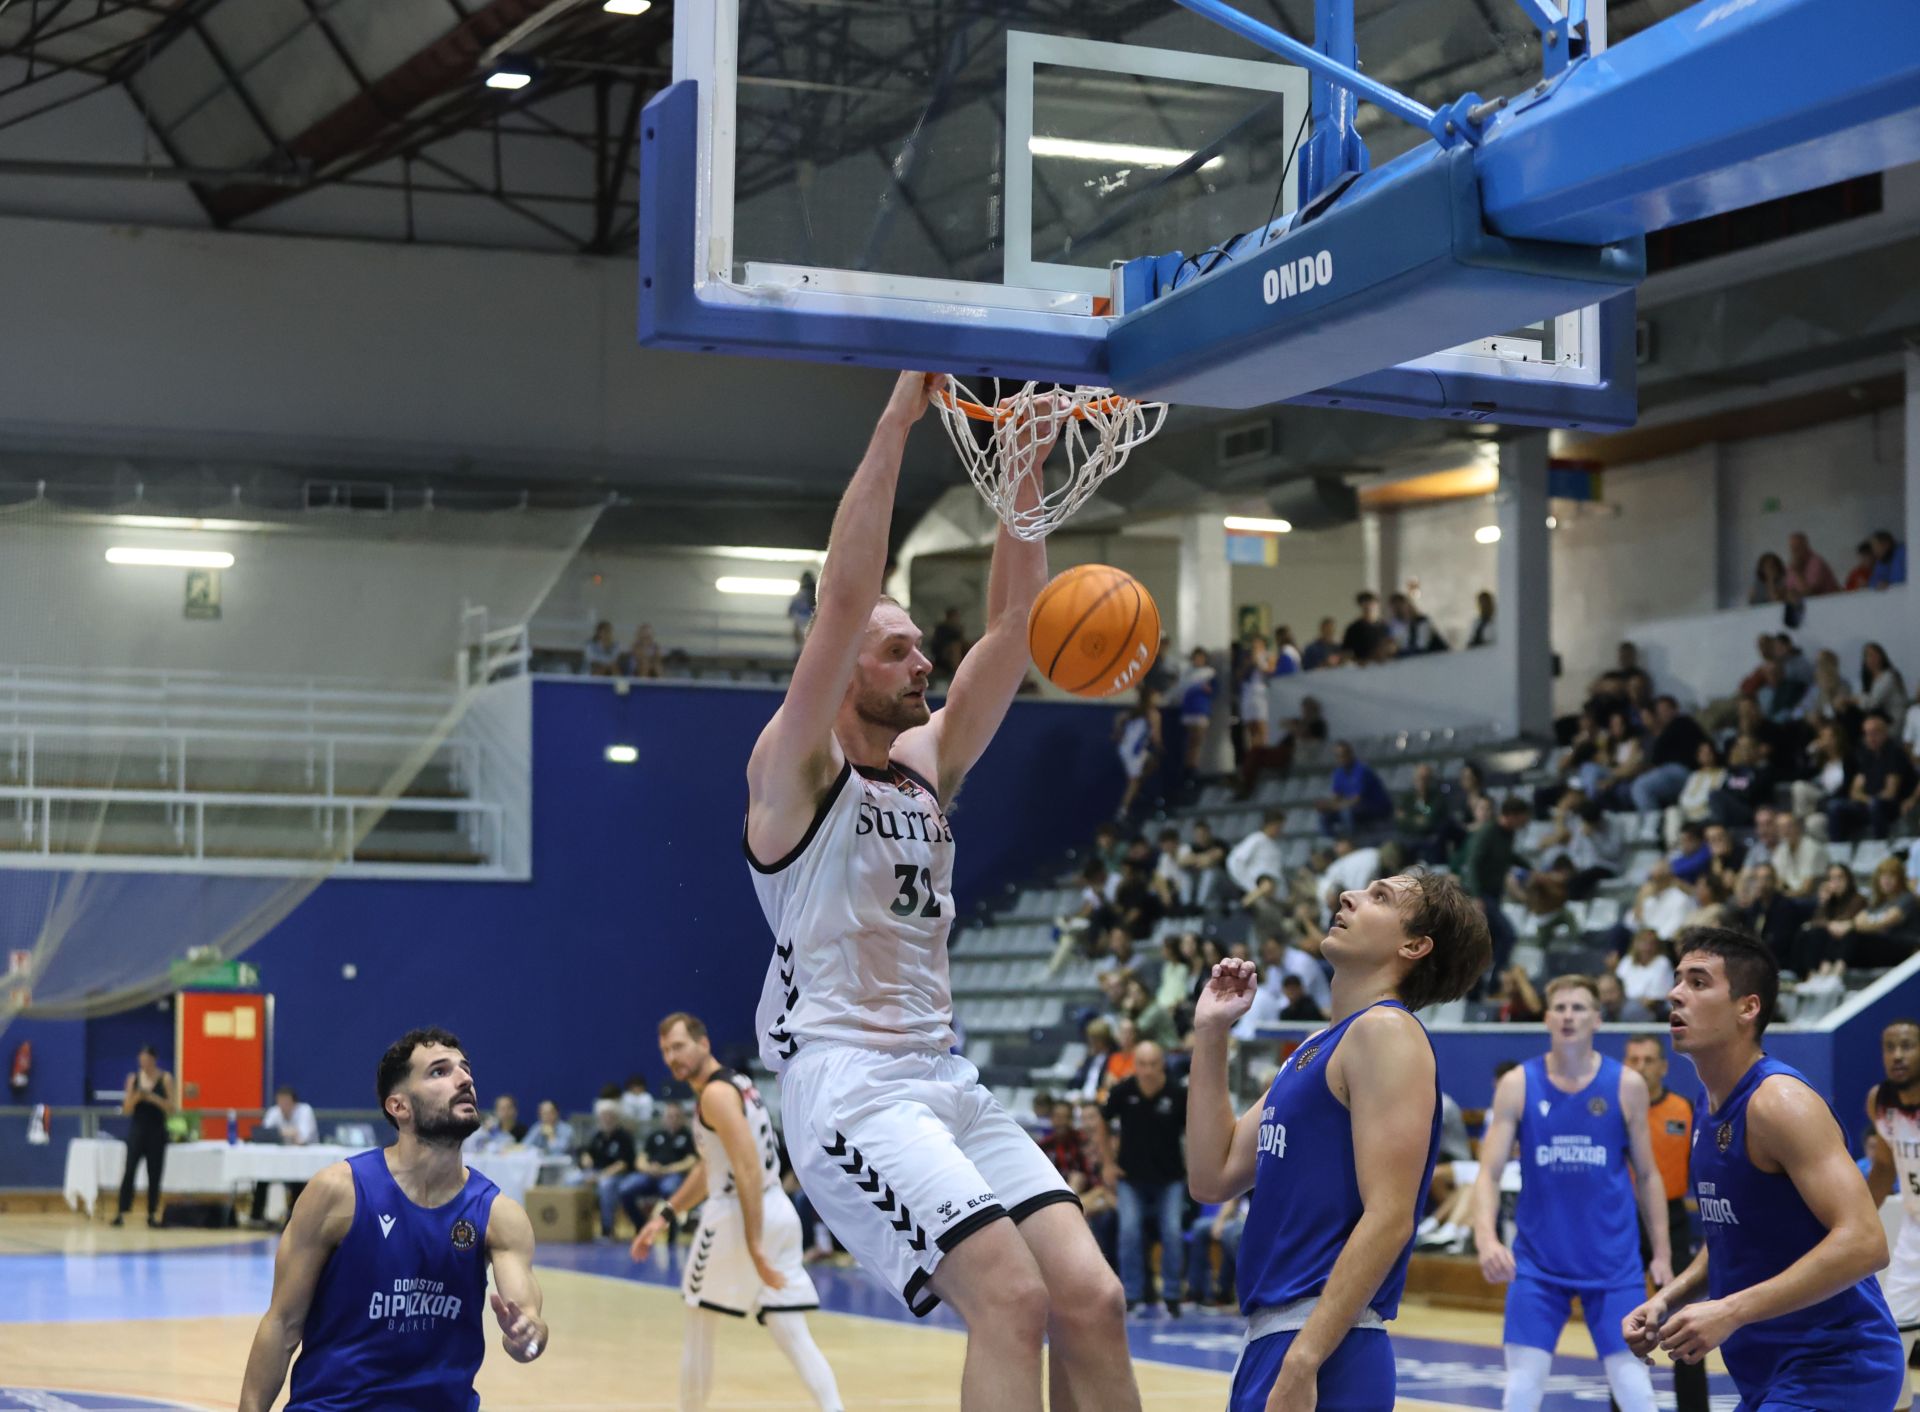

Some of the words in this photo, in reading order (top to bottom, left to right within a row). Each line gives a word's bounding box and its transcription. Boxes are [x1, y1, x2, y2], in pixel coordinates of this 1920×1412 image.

[1263, 249, 1333, 305] ONDO
[890, 863, 942, 918] 32
[967, 1199, 980, 1209] EL
[369, 1291, 462, 1320] GIPUZKOA
[387, 1318, 436, 1334] BASKET
